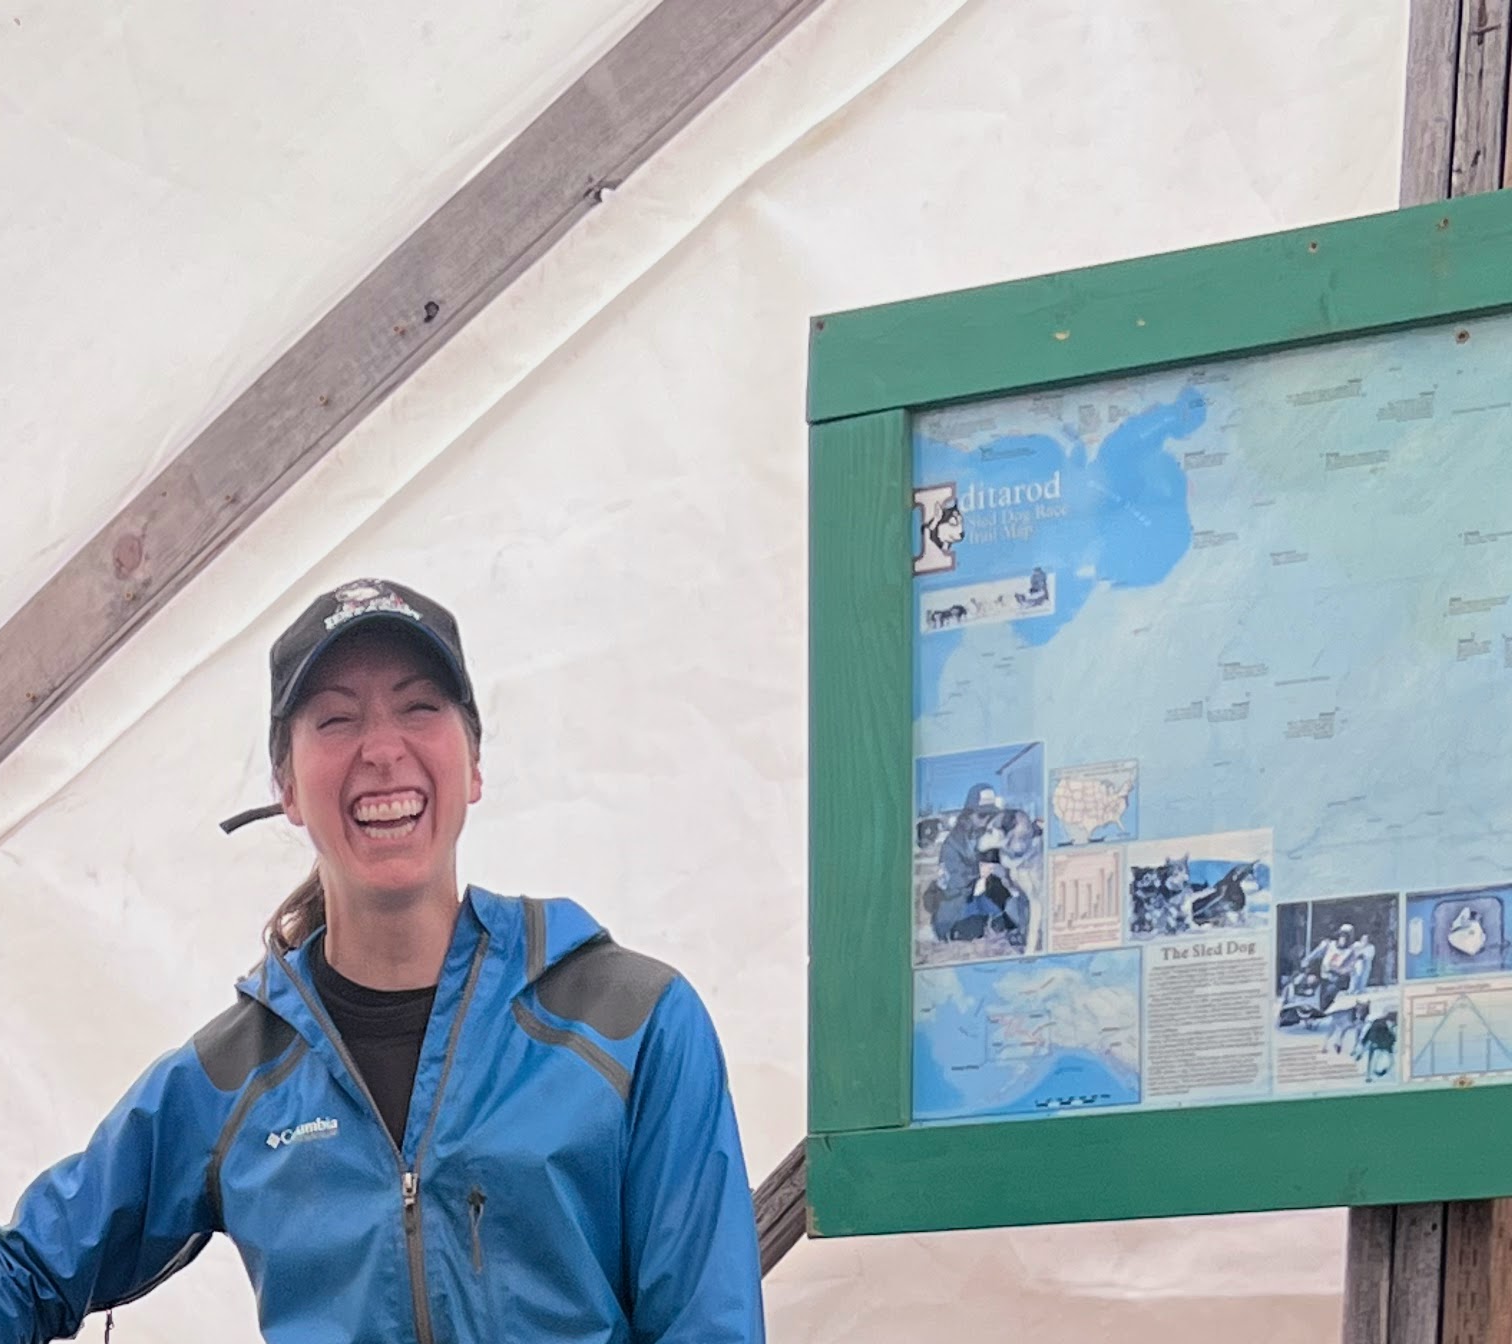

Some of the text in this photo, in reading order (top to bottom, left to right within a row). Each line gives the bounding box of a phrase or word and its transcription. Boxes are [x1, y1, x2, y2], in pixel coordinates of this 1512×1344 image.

[1160, 940, 1257, 961] The Sled Dog
